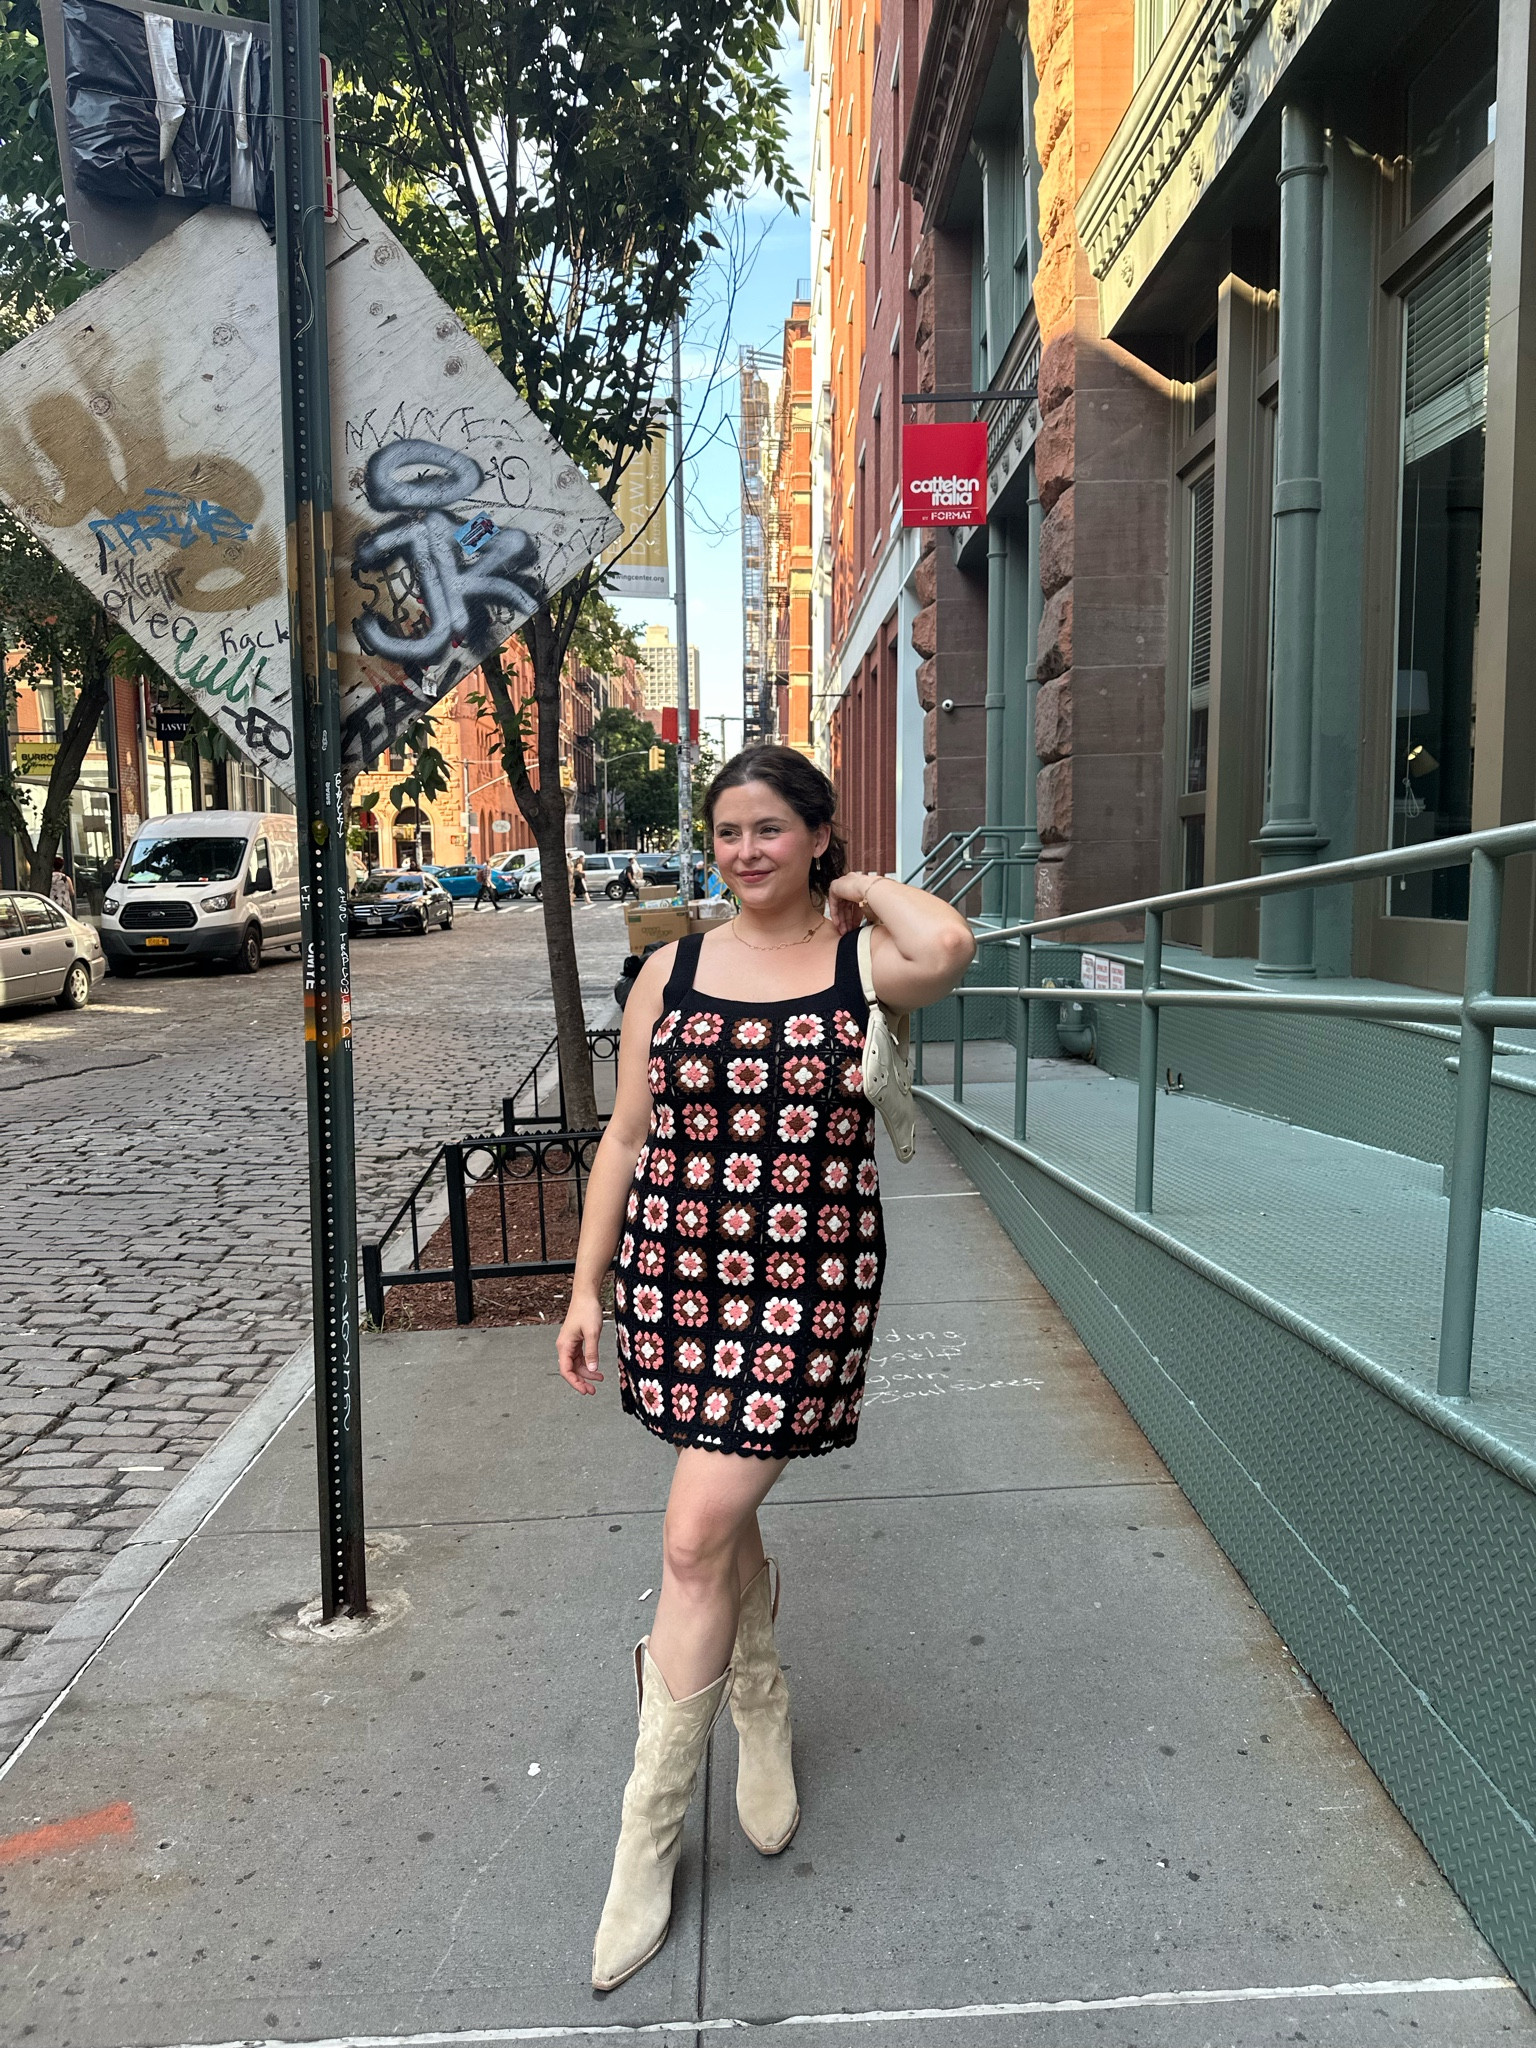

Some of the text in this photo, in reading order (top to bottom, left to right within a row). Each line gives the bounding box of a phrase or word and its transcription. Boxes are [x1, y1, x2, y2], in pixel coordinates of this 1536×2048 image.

[651, 448, 660, 480] SOHO
[910, 475, 980, 494] cattelan
[631, 451, 646, 556] DRAWIN
[931, 490, 973, 506] italia
[652, 497, 661, 547] MUSEM
[931, 511, 972, 521] FORMAT
[653, 548, 661, 556] A
[613, 574, 665, 583] wingcenter.org
[161, 723, 190, 731] LASVI
[21, 753, 57, 761] BURRO
[869, 1346, 963, 1368] yself
[864, 1372, 950, 1390] gain
